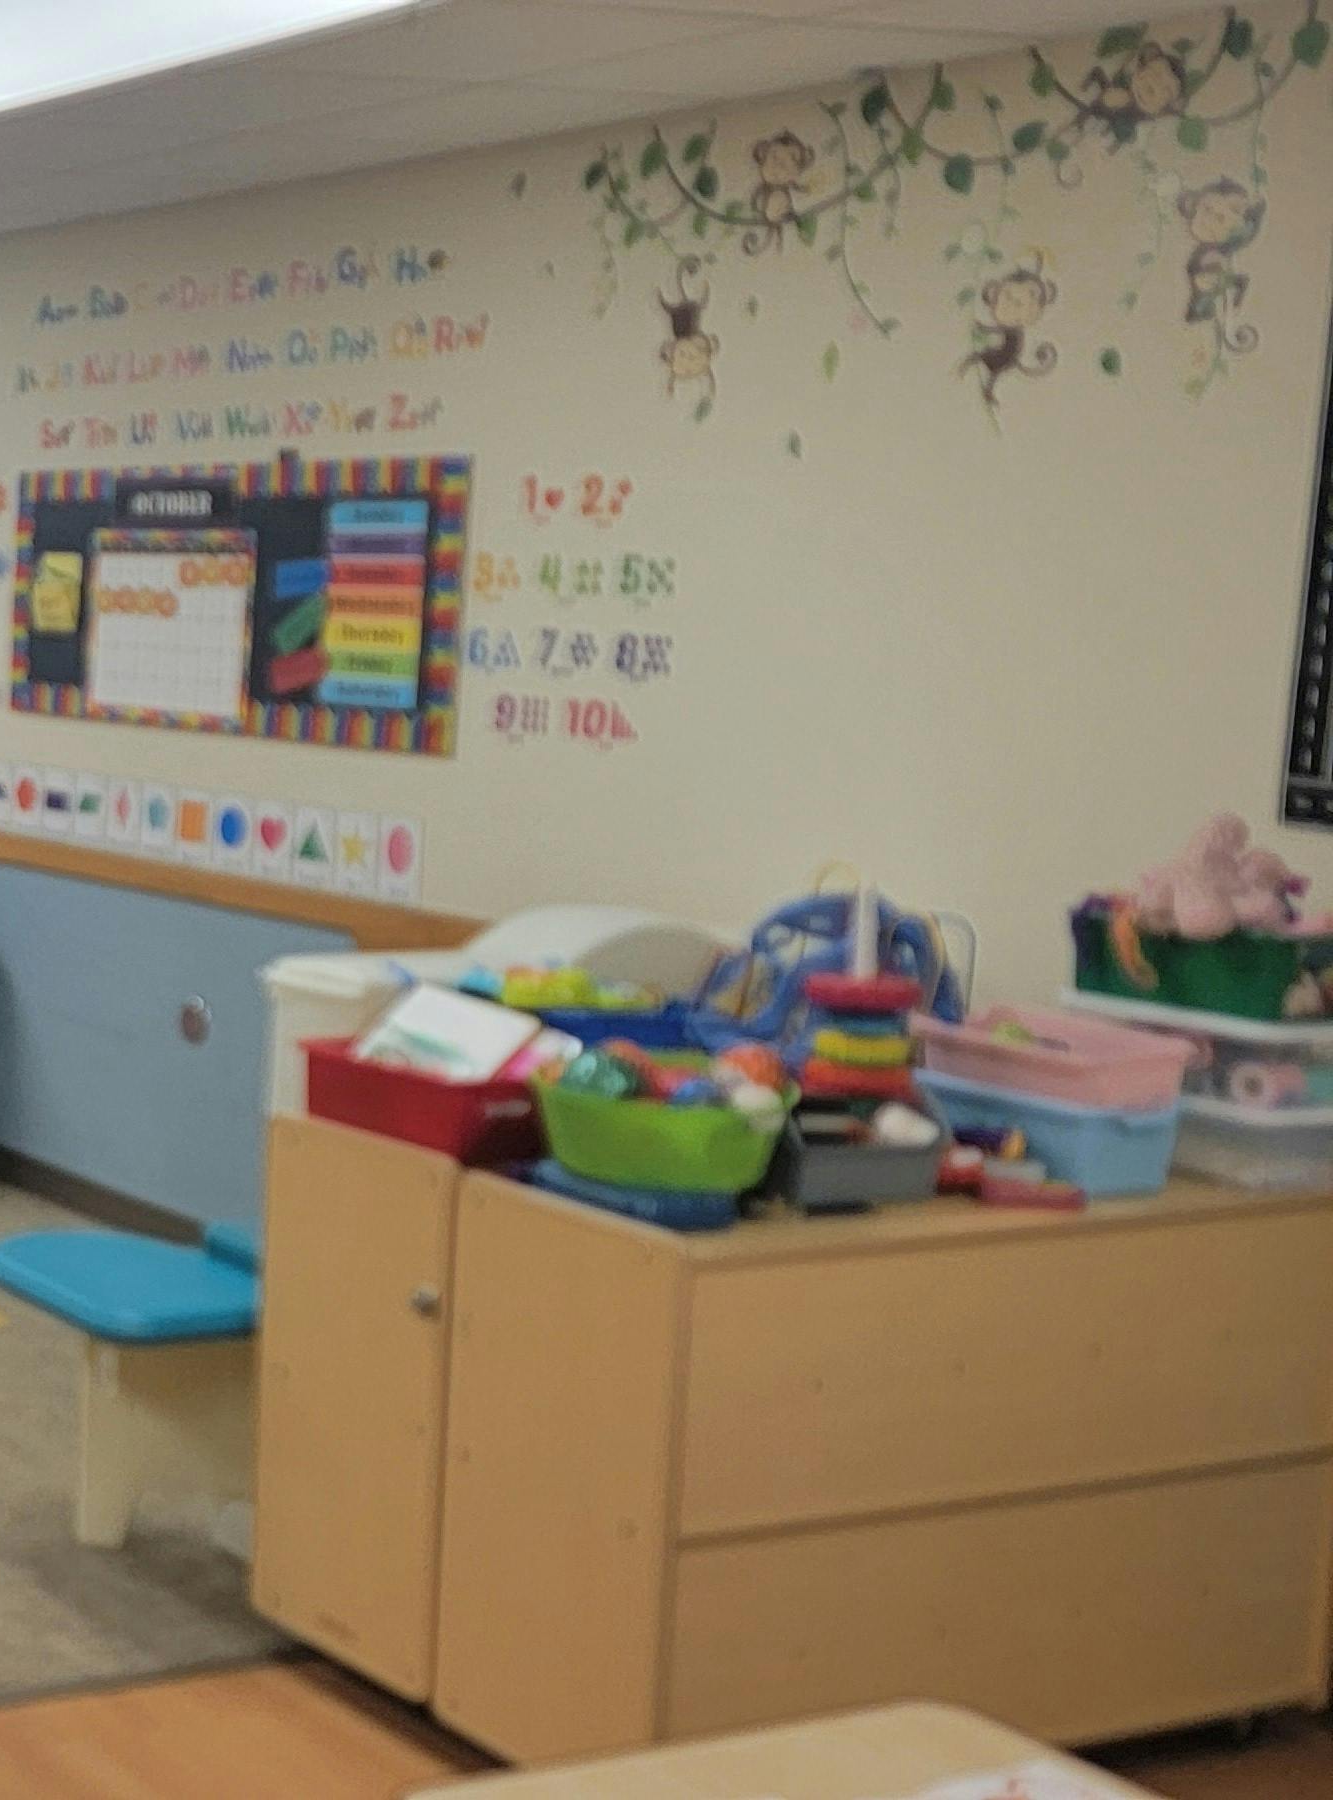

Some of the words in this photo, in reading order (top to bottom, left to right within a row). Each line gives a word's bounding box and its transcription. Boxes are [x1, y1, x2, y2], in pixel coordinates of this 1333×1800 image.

[525, 474, 538, 515] 1
[581, 474, 604, 516] 2
[539, 552, 563, 594] 4
[619, 552, 643, 595] 5
[539, 627, 561, 669] 7
[566, 697, 608, 740] 10
